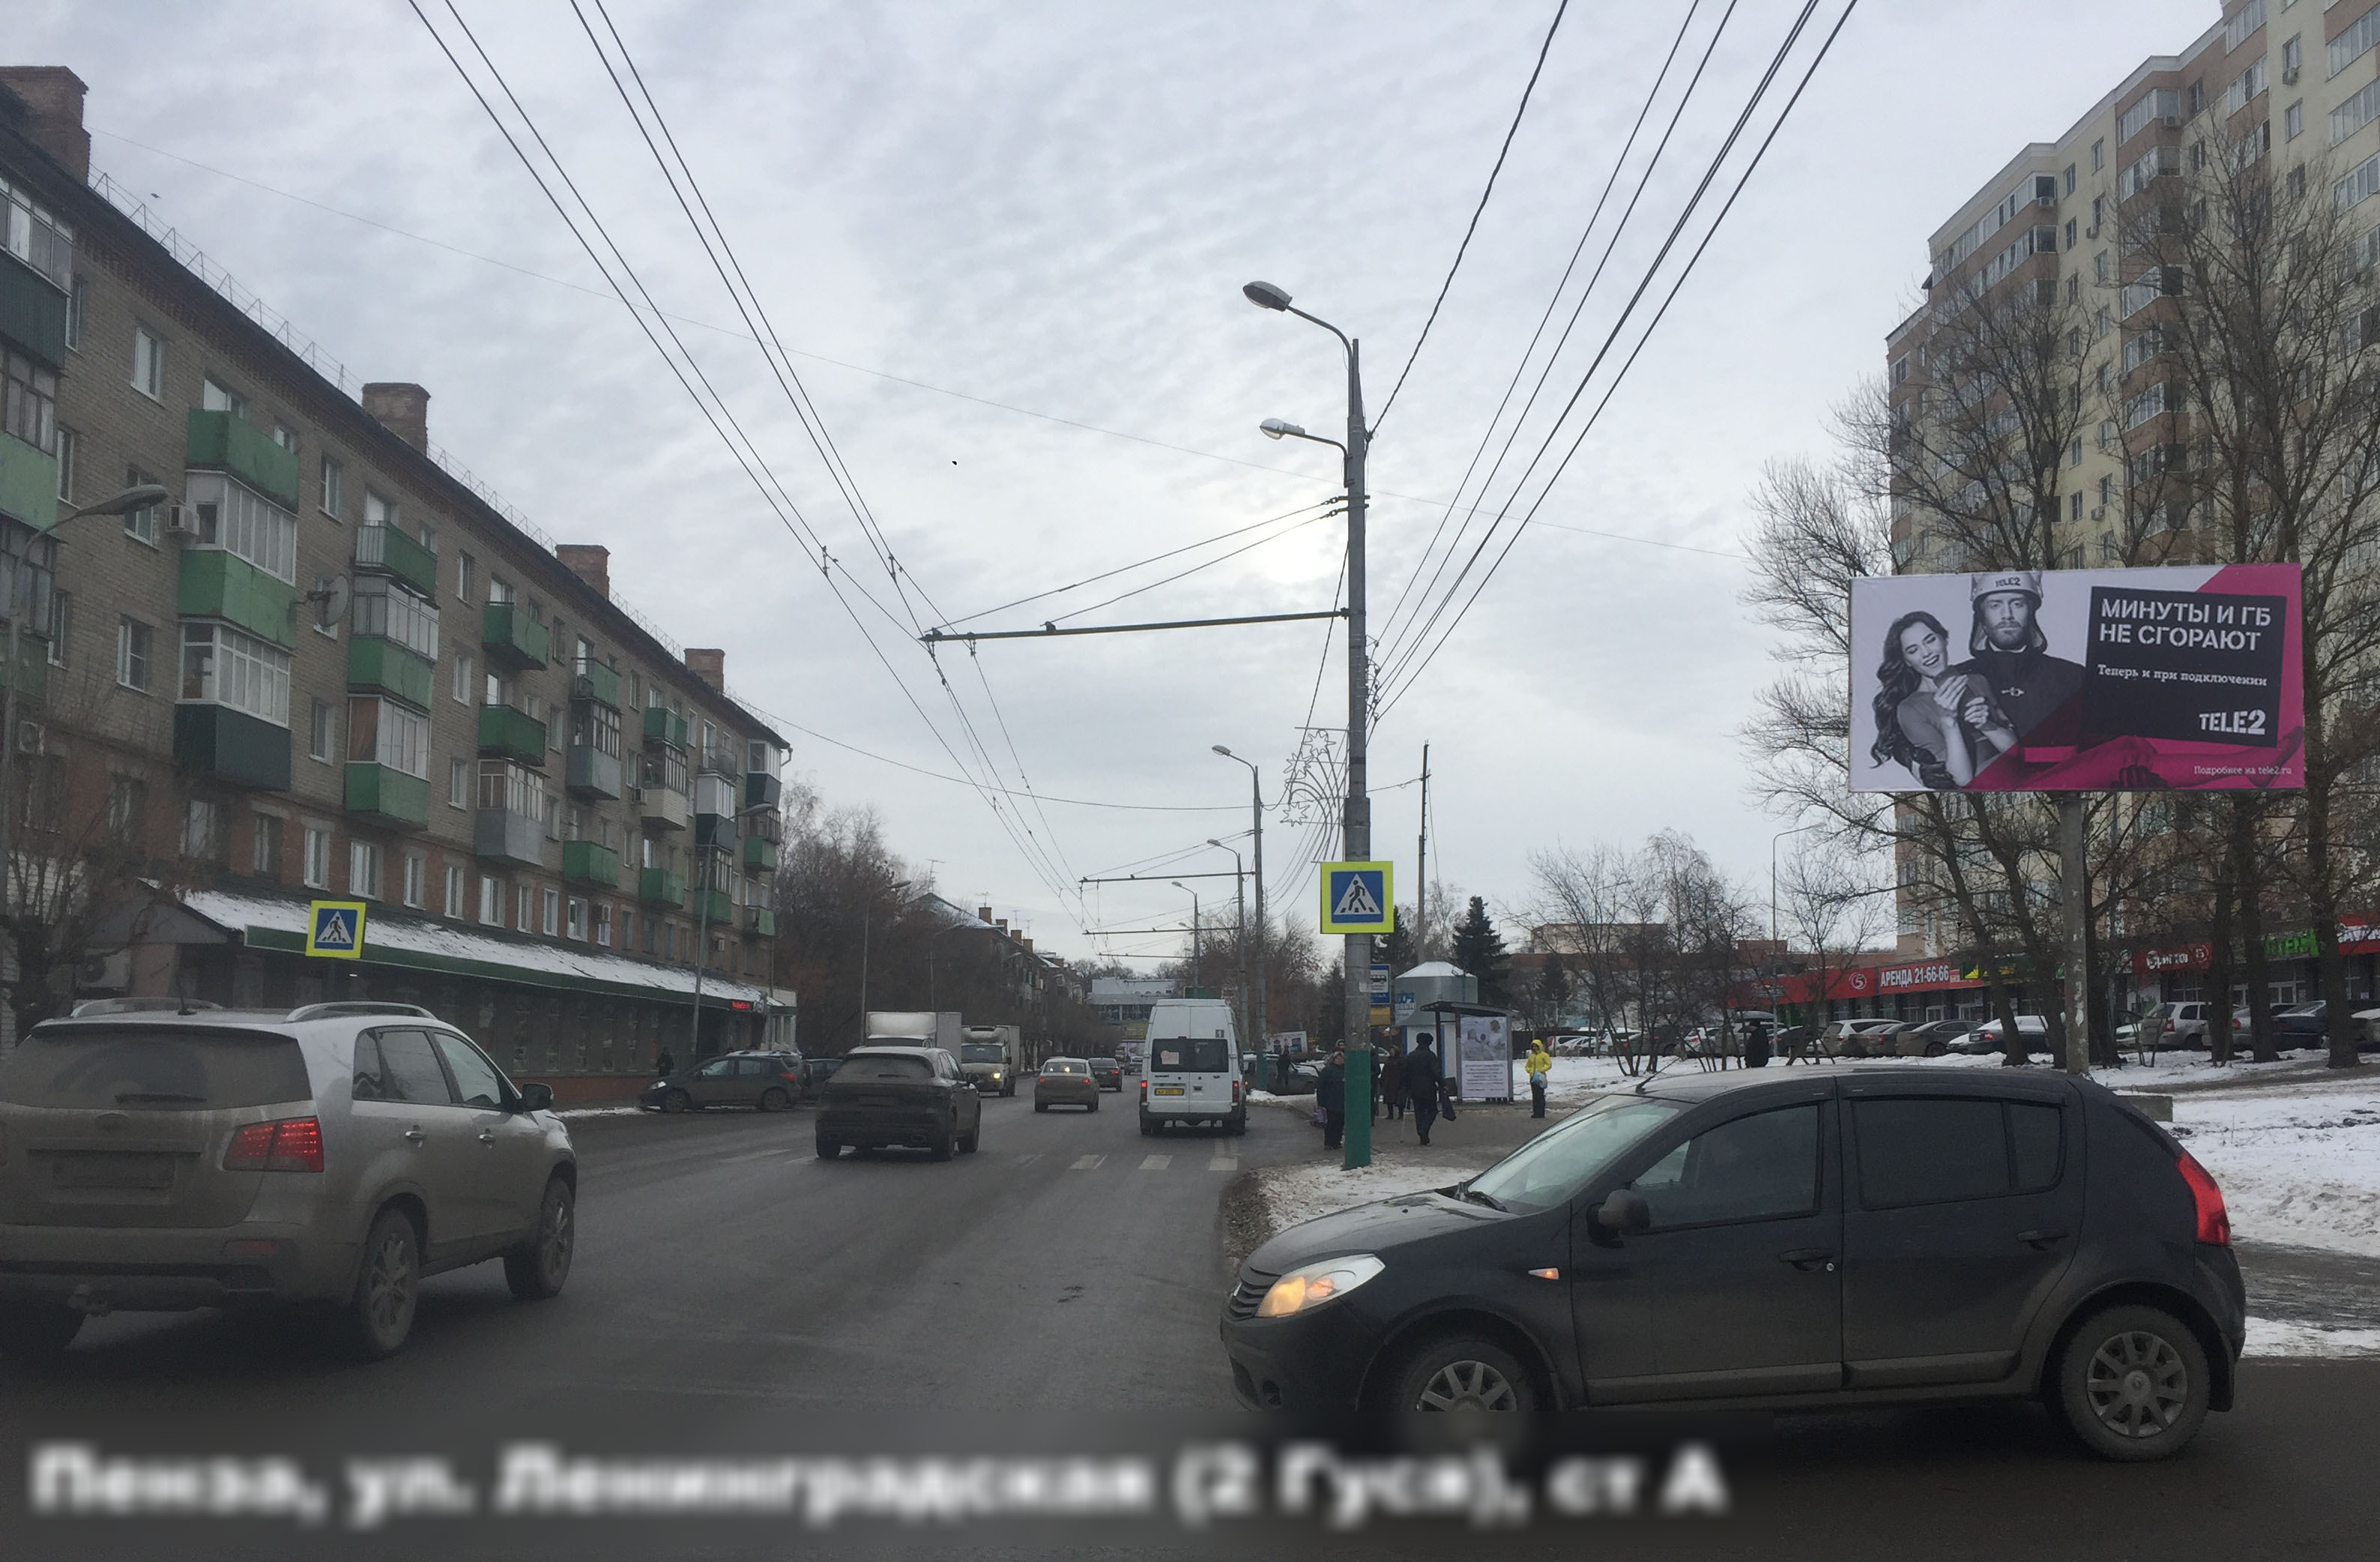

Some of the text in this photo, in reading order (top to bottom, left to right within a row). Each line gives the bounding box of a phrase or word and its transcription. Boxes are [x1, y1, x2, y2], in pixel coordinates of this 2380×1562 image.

[2100, 599, 2271, 627] МИНУТЫ И ГБ
[2099, 623, 2261, 651] НЕ СГОРАЮТ
[2097, 664, 2268, 687] Теперь и при подключении
[2199, 709, 2266, 735] TELE2
[2194, 766, 2243, 776] Подробнее
[2258, 765, 2292, 775] tele2.ru
[1880, 965, 1949, 988] АРЕНДА 21-66-66
